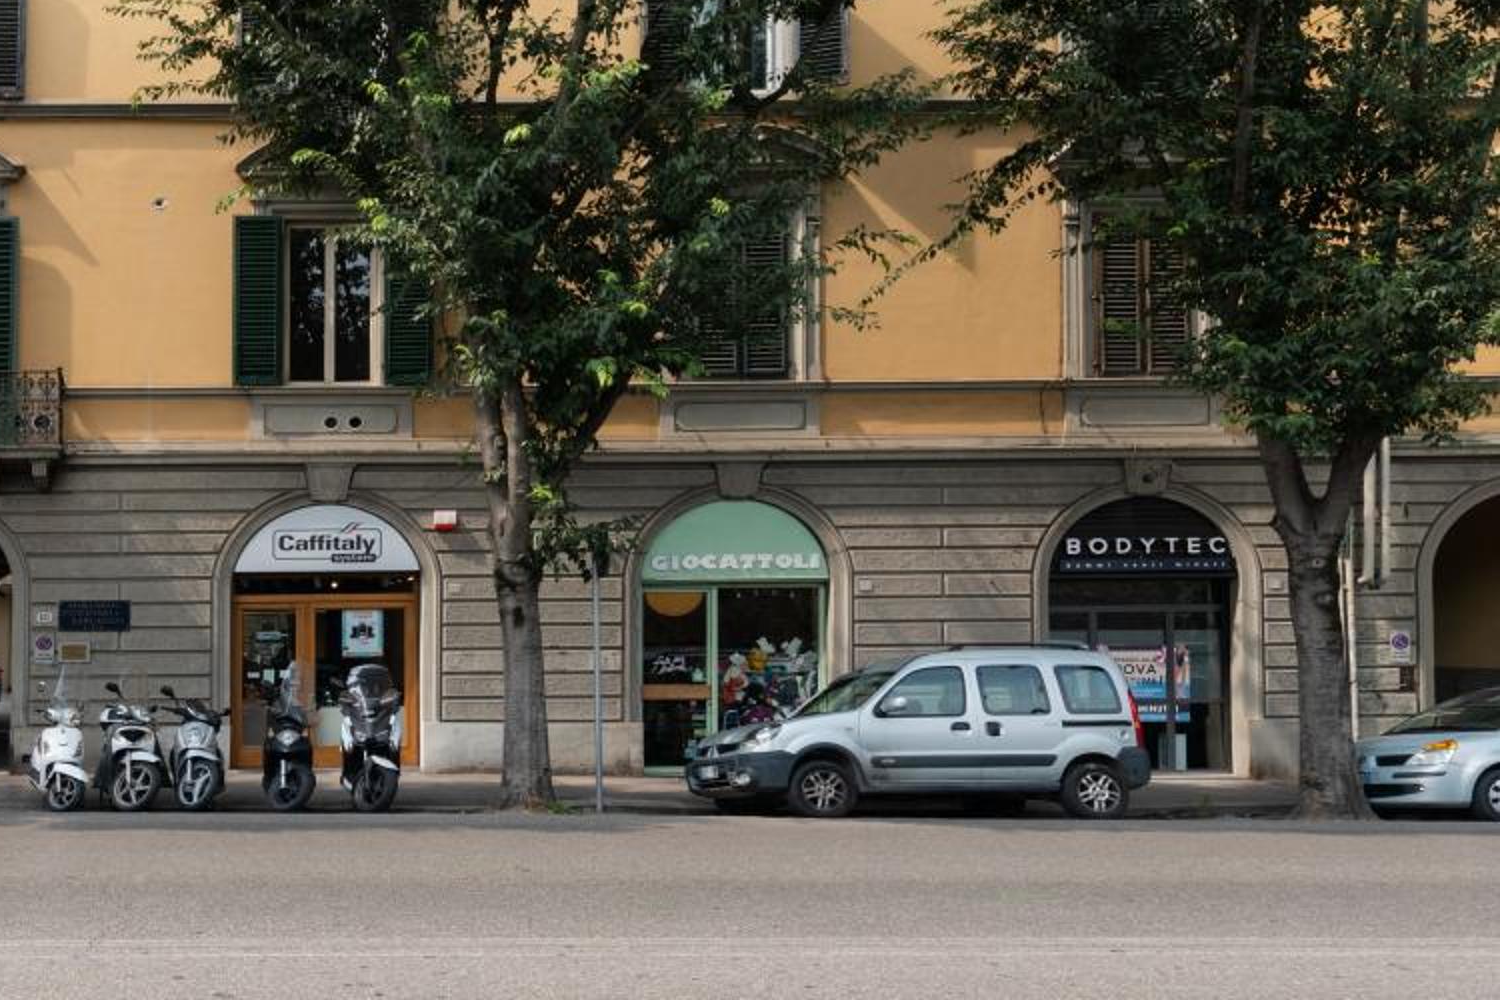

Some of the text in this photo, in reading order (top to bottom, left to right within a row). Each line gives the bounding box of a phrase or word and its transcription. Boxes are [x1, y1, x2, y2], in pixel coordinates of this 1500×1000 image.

[279, 534, 375, 555] Caffitaly
[1066, 537, 1226, 554] BODYTEC
[652, 553, 821, 570] GIOCATTOLI
